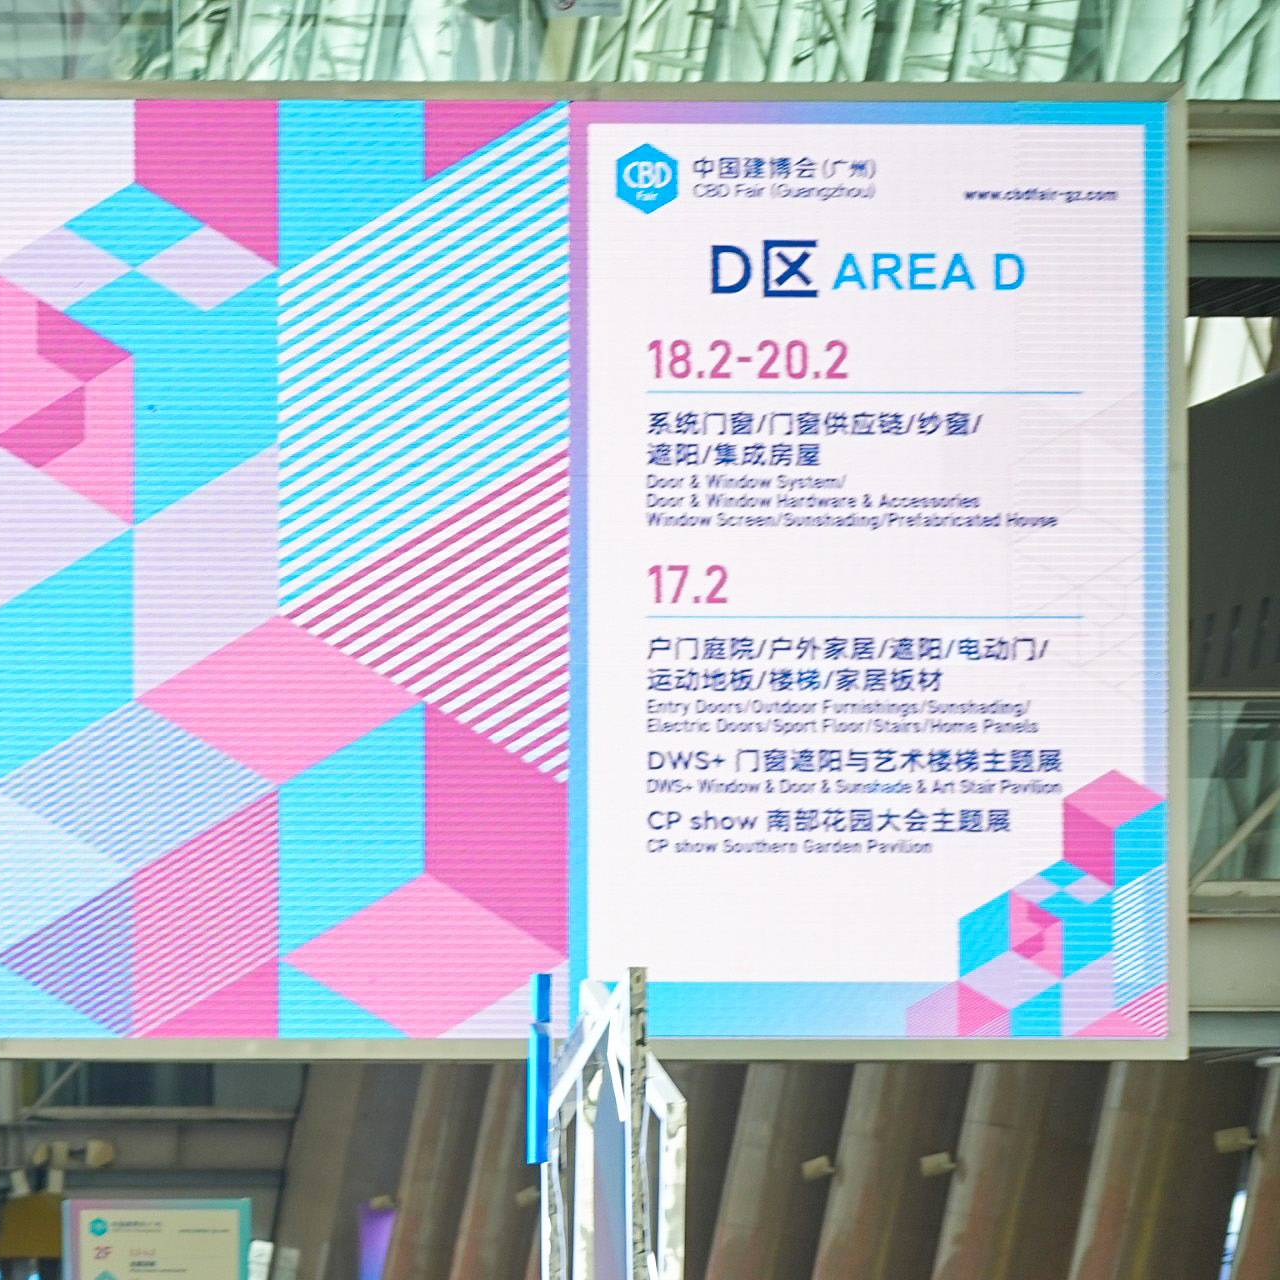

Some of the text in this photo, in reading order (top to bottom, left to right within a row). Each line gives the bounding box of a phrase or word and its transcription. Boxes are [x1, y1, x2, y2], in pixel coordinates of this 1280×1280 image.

[623, 161, 673, 188] CBD
[832, 253, 976, 290] AREA
[994, 253, 1026, 290] D
[646, 340, 851, 380] 18.2-20.2
[646, 565, 729, 604] 17.2
[647, 751, 726, 770] DWS+
[647, 808, 1011, 834] CP show 南部花园大会主题展
